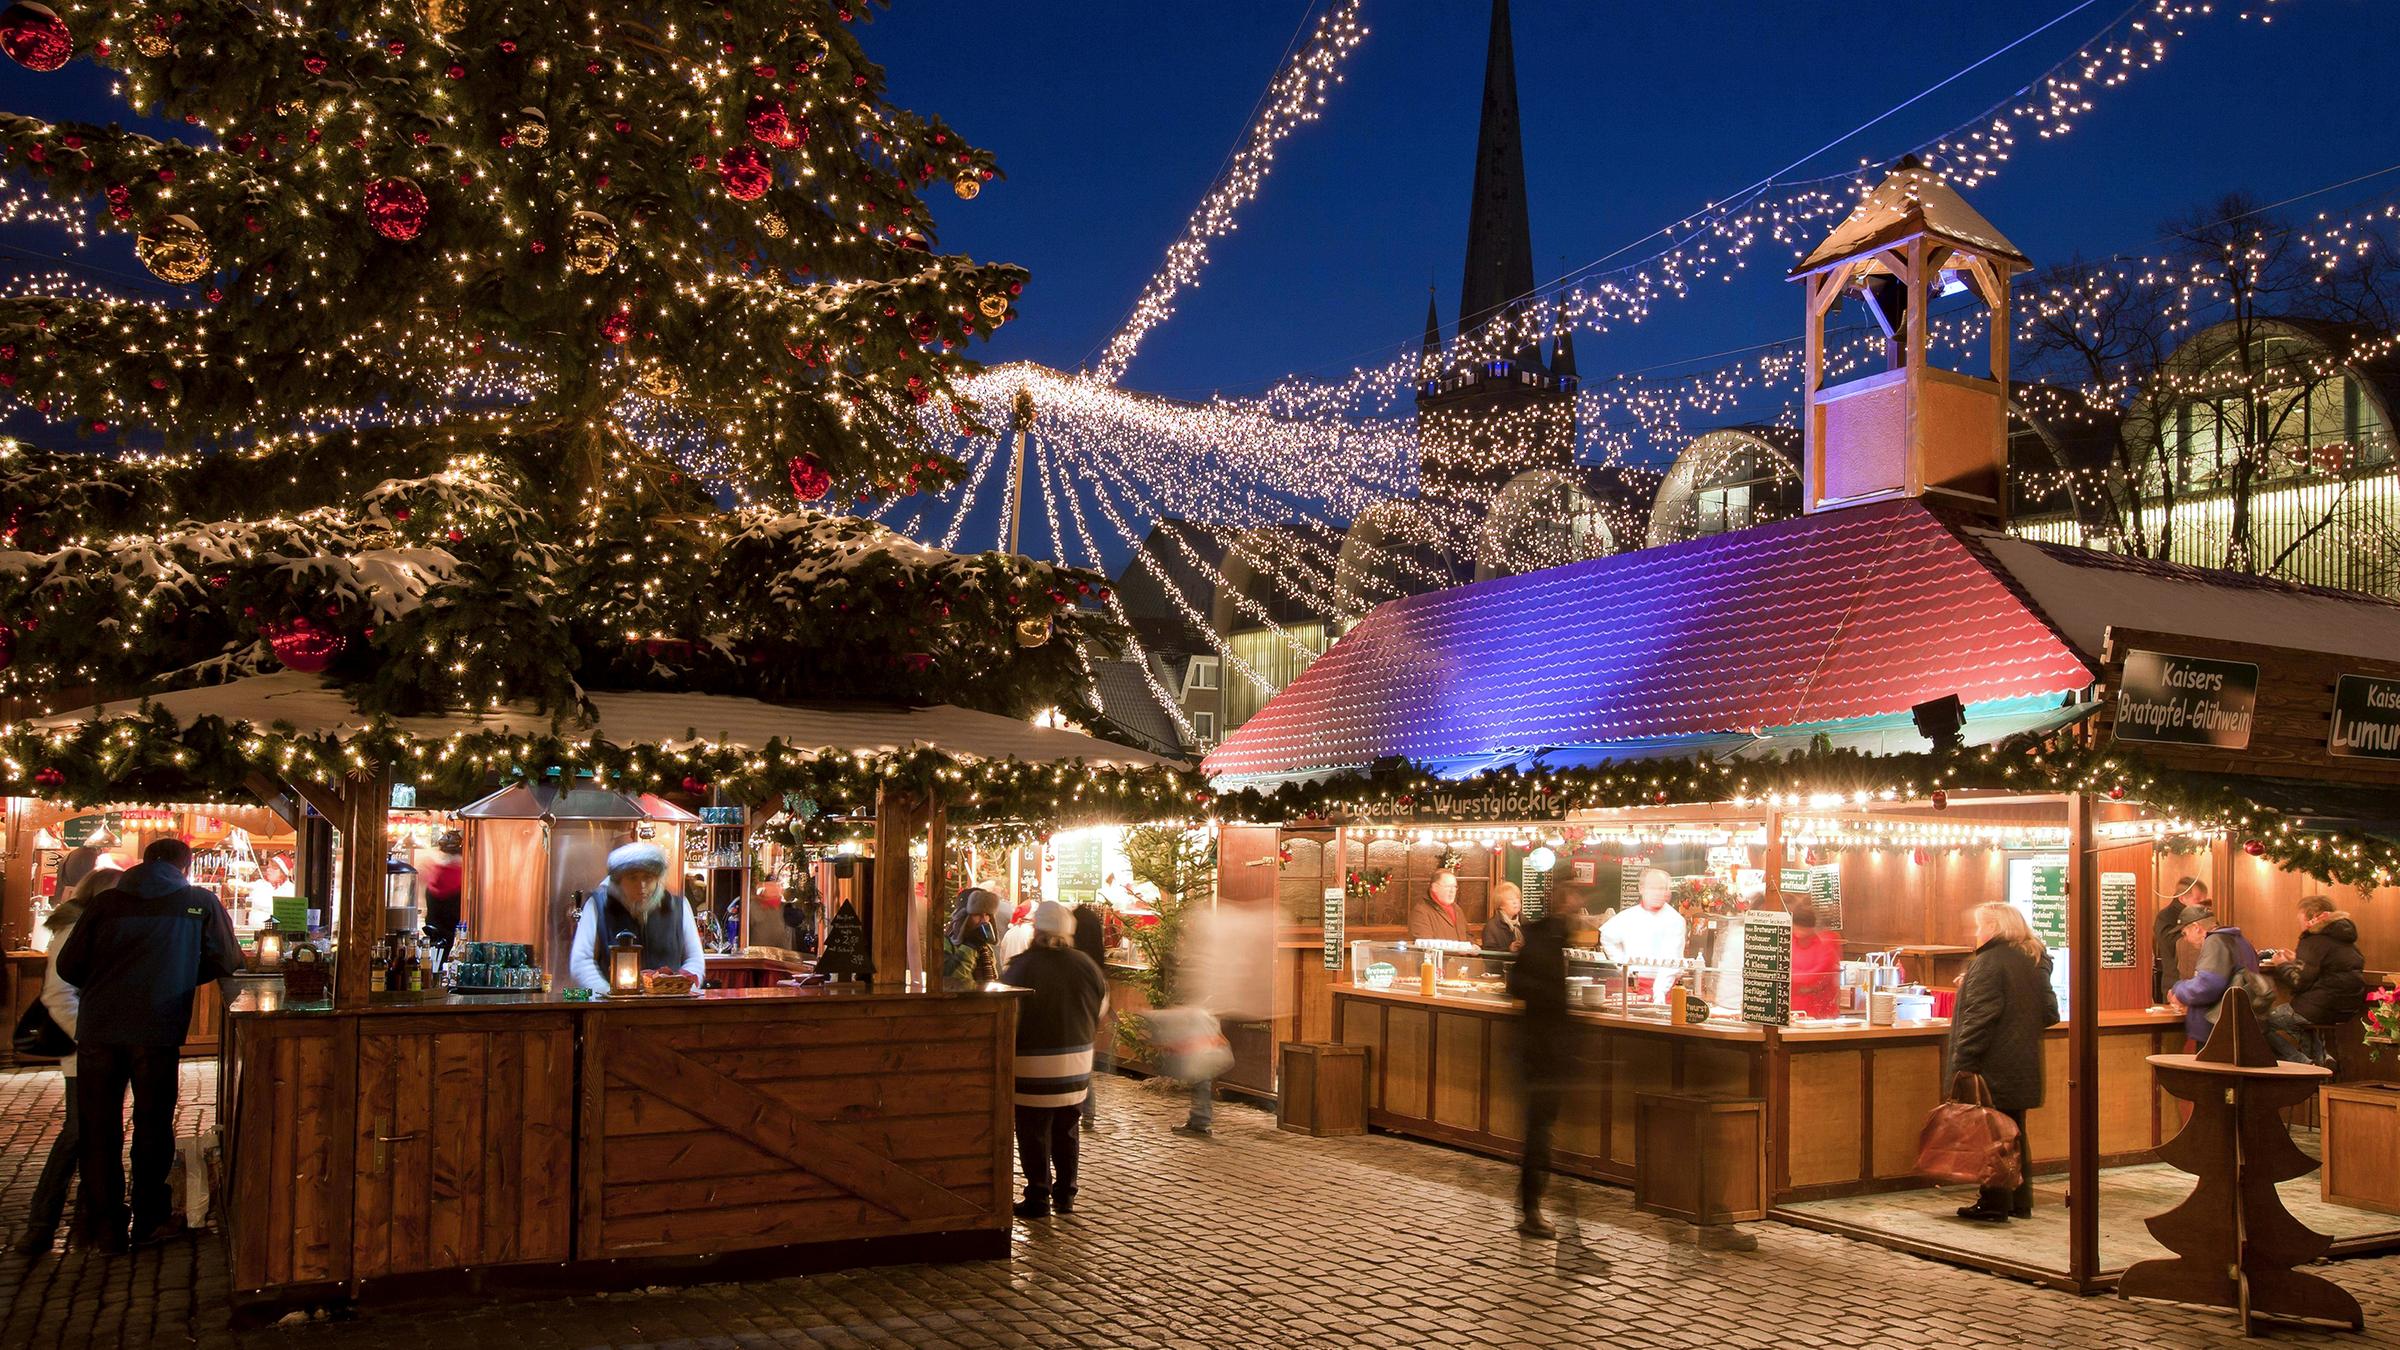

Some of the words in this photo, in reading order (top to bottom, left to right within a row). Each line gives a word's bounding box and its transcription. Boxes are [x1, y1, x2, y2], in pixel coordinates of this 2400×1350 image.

[2161, 662, 2223, 691] Kaisers
[2118, 693, 2251, 735] Bratapfel-Glühwein
[1686, 1003, 1707, 1013] twurst
